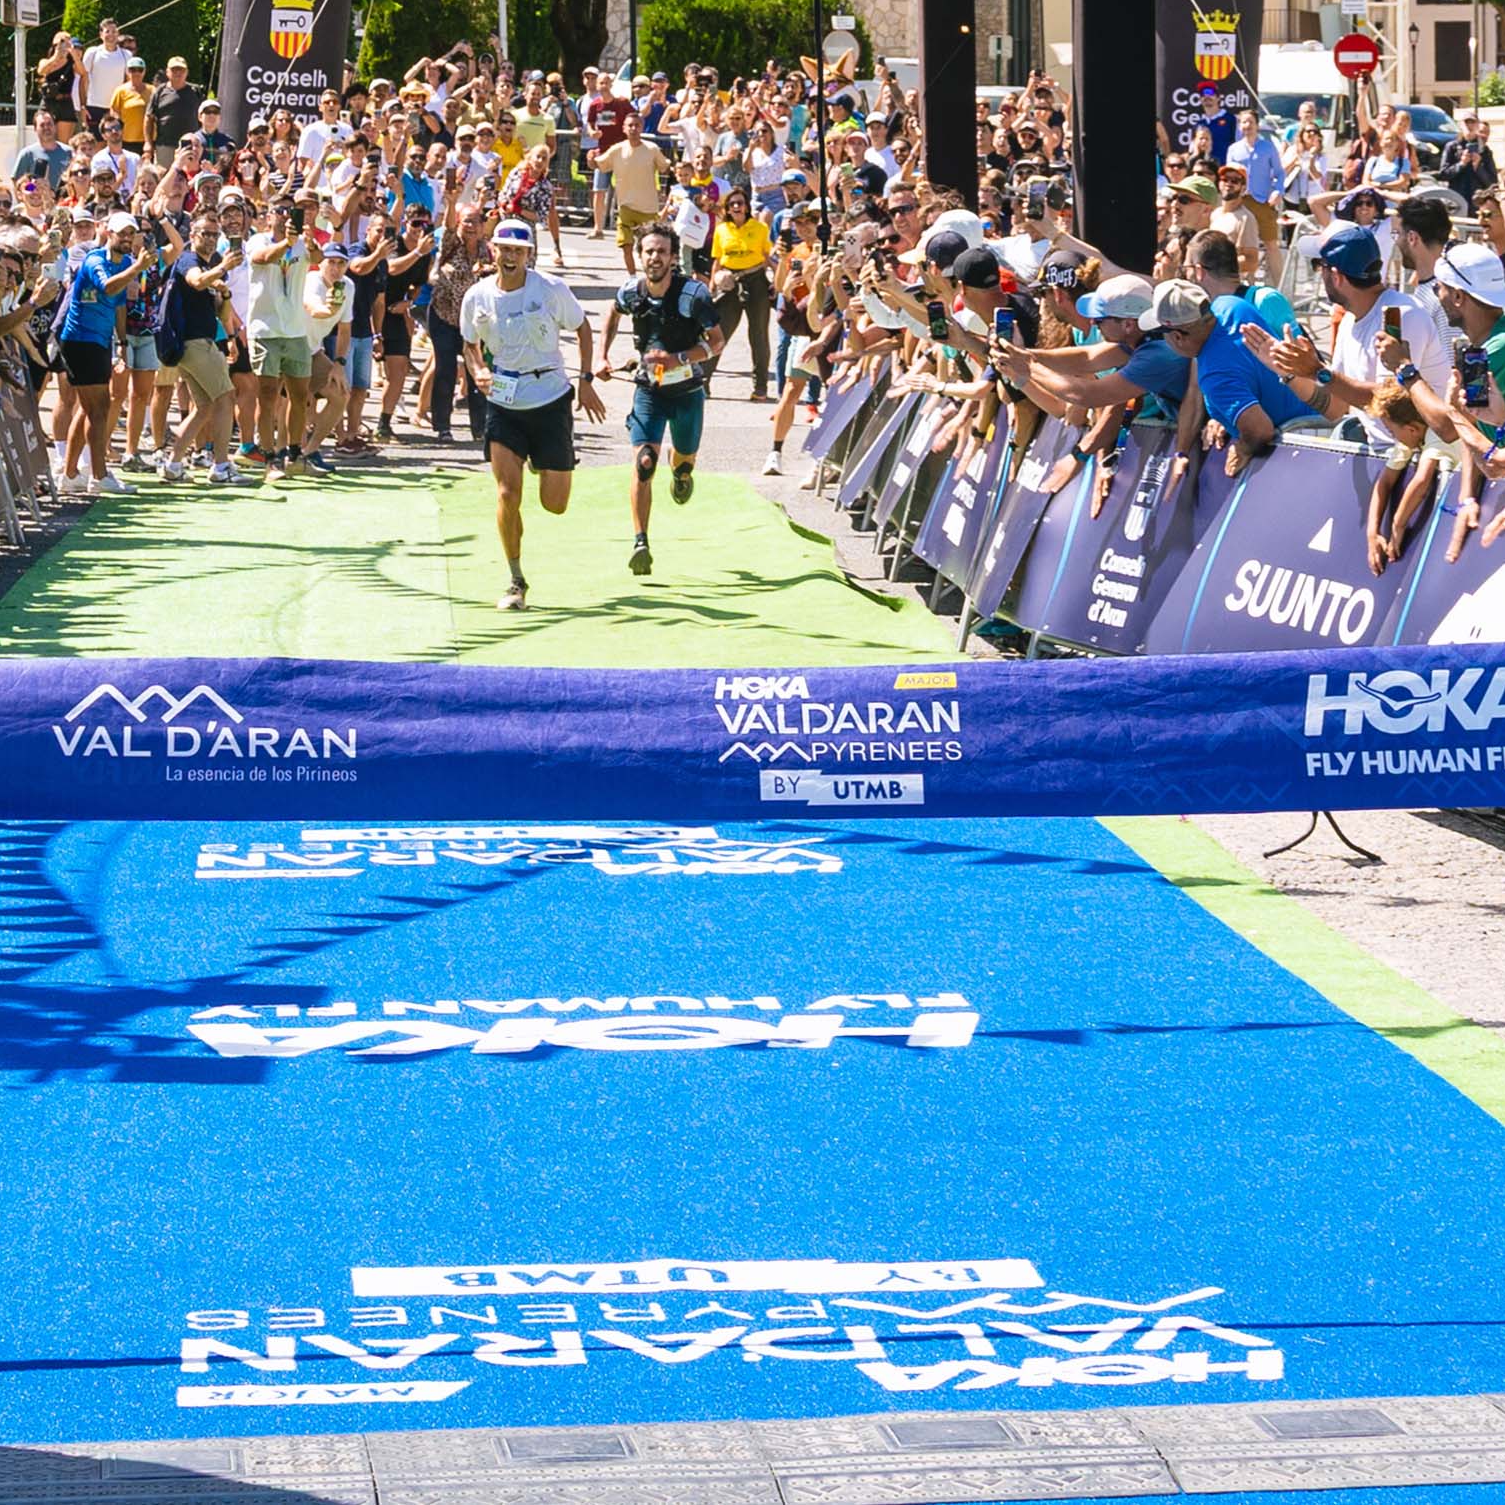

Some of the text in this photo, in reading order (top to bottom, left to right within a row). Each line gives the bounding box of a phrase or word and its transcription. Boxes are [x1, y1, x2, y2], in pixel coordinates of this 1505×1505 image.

[247, 66, 327, 87] Conselh
[1172, 88, 1249, 107] Coelh
[1224, 559, 1375, 645] SUUNTO
[714, 676, 810, 700] HOKA
[904, 676, 950, 686] MAJOR
[52, 720, 357, 758] VAL D'ARAN
[813, 741, 962, 762] PYRENEES
[1306, 751, 1356, 777] FLY
[1362, 748, 1481, 775] HUMAN
[166, 766, 357, 783] La esencia de los Pirineos
[774, 776, 903, 800] BY UTMB
[856, 1348, 1285, 1392] HOKA
